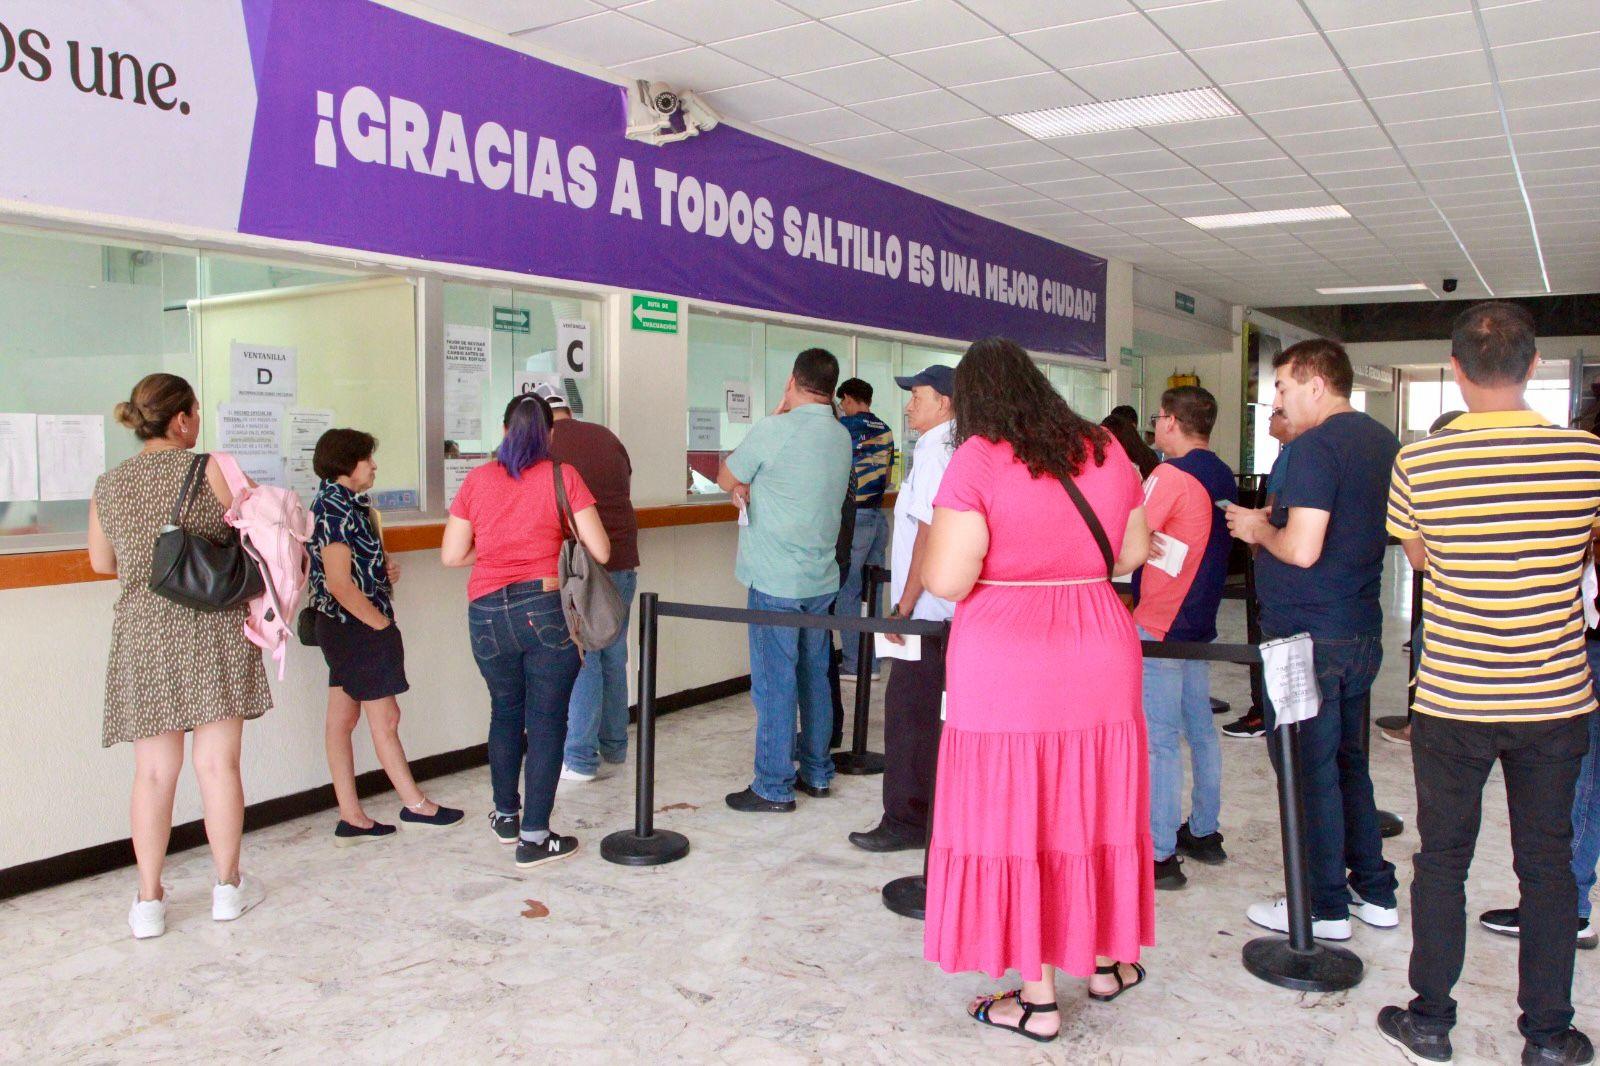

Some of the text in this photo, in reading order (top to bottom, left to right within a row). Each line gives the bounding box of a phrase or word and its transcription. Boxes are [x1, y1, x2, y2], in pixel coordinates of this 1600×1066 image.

[66, 40, 190, 117] une.
[314, 85, 1098, 325] ¡GRACIAS A TODOS SALTILLO ES UNA MEJOR CIUDAD!
[243, 351, 287, 361] VENTANILLA
[566, 339, 584, 374] C
[256, 367, 273, 385] D
[548, 839, 560, 852] N
